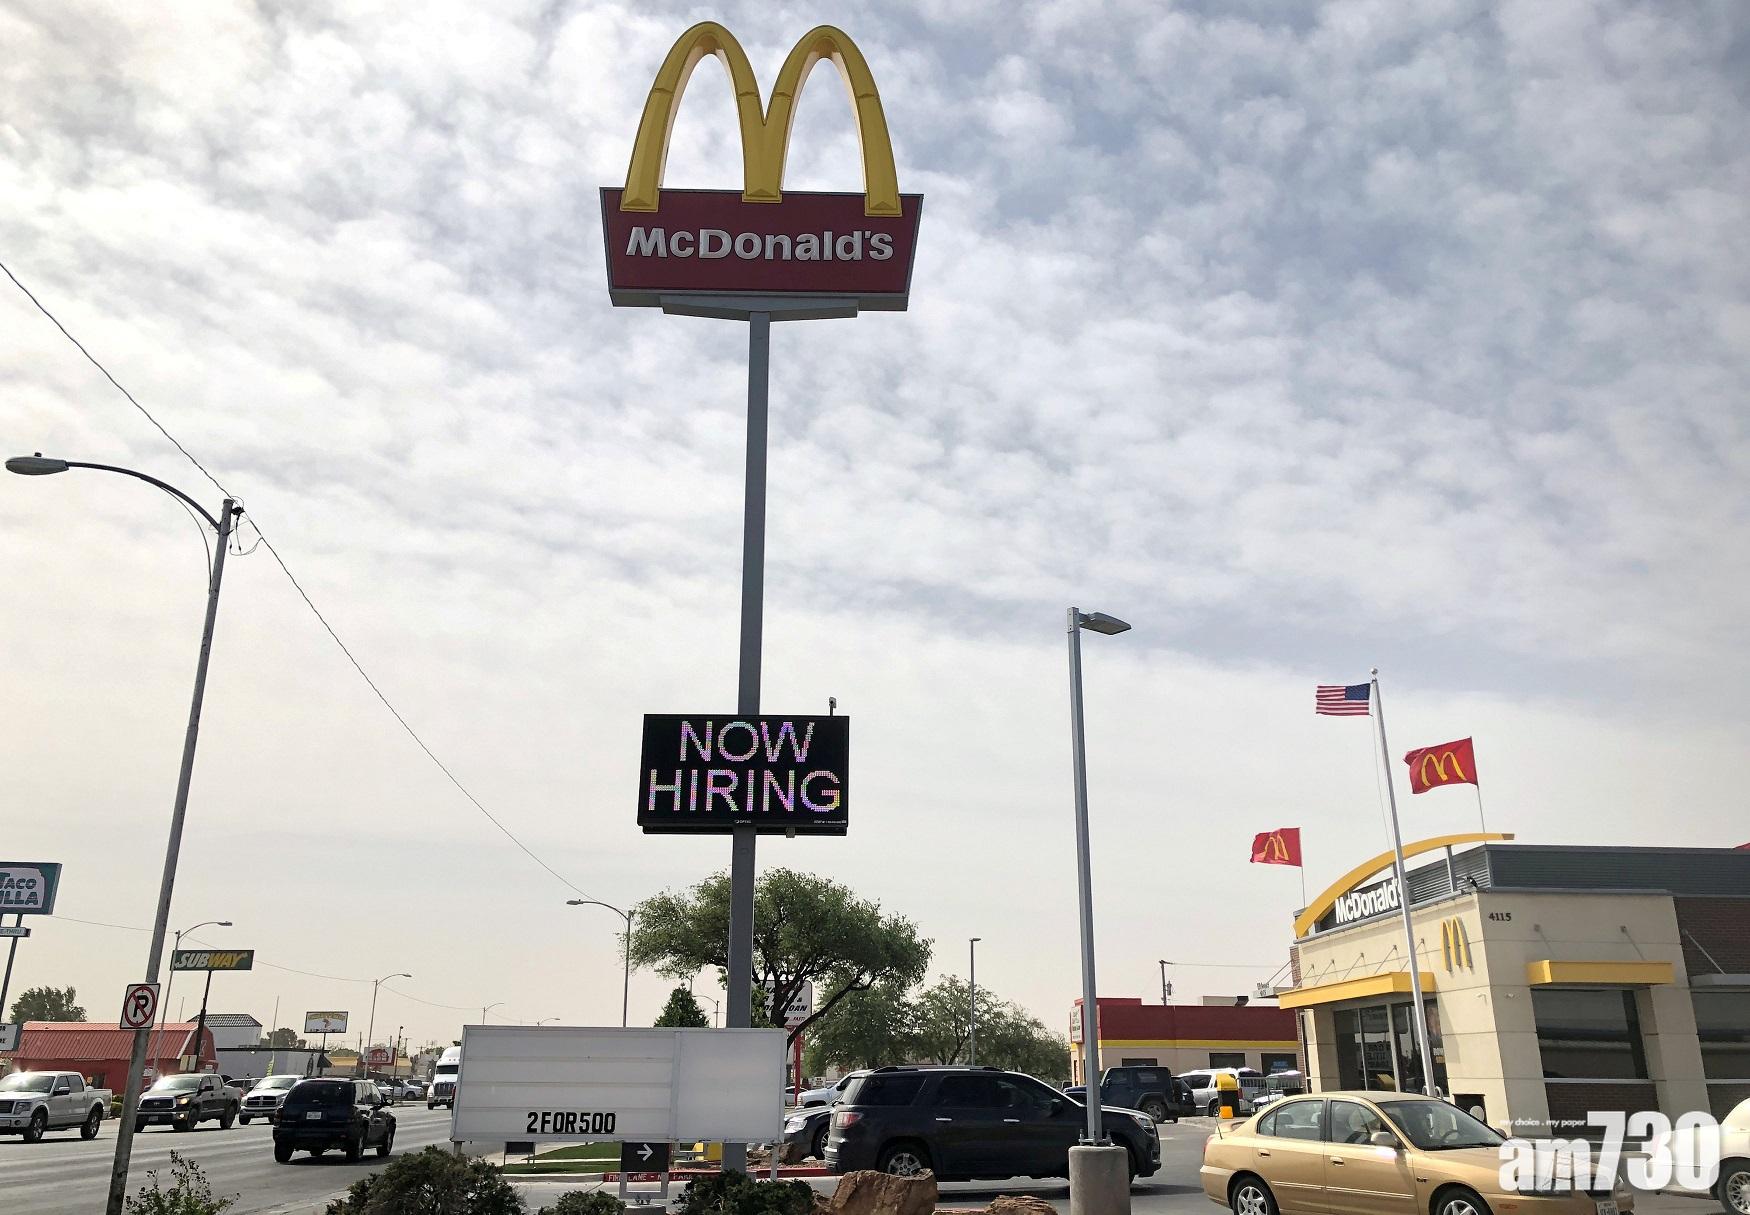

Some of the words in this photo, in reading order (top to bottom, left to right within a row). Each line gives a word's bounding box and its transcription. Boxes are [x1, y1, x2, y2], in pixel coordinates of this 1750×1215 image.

[626, 226, 894, 260] McDonald's
[679, 720, 815, 762] NOW
[648, 768, 841, 812] HIRING
[0, 890, 39, 905] ILLA
[1488, 912, 1512, 922] 4115
[174, 952, 248, 968] SUBWAY
[628, 1173, 647, 1181] LANE
[673, 1173, 694, 1181] PARK
